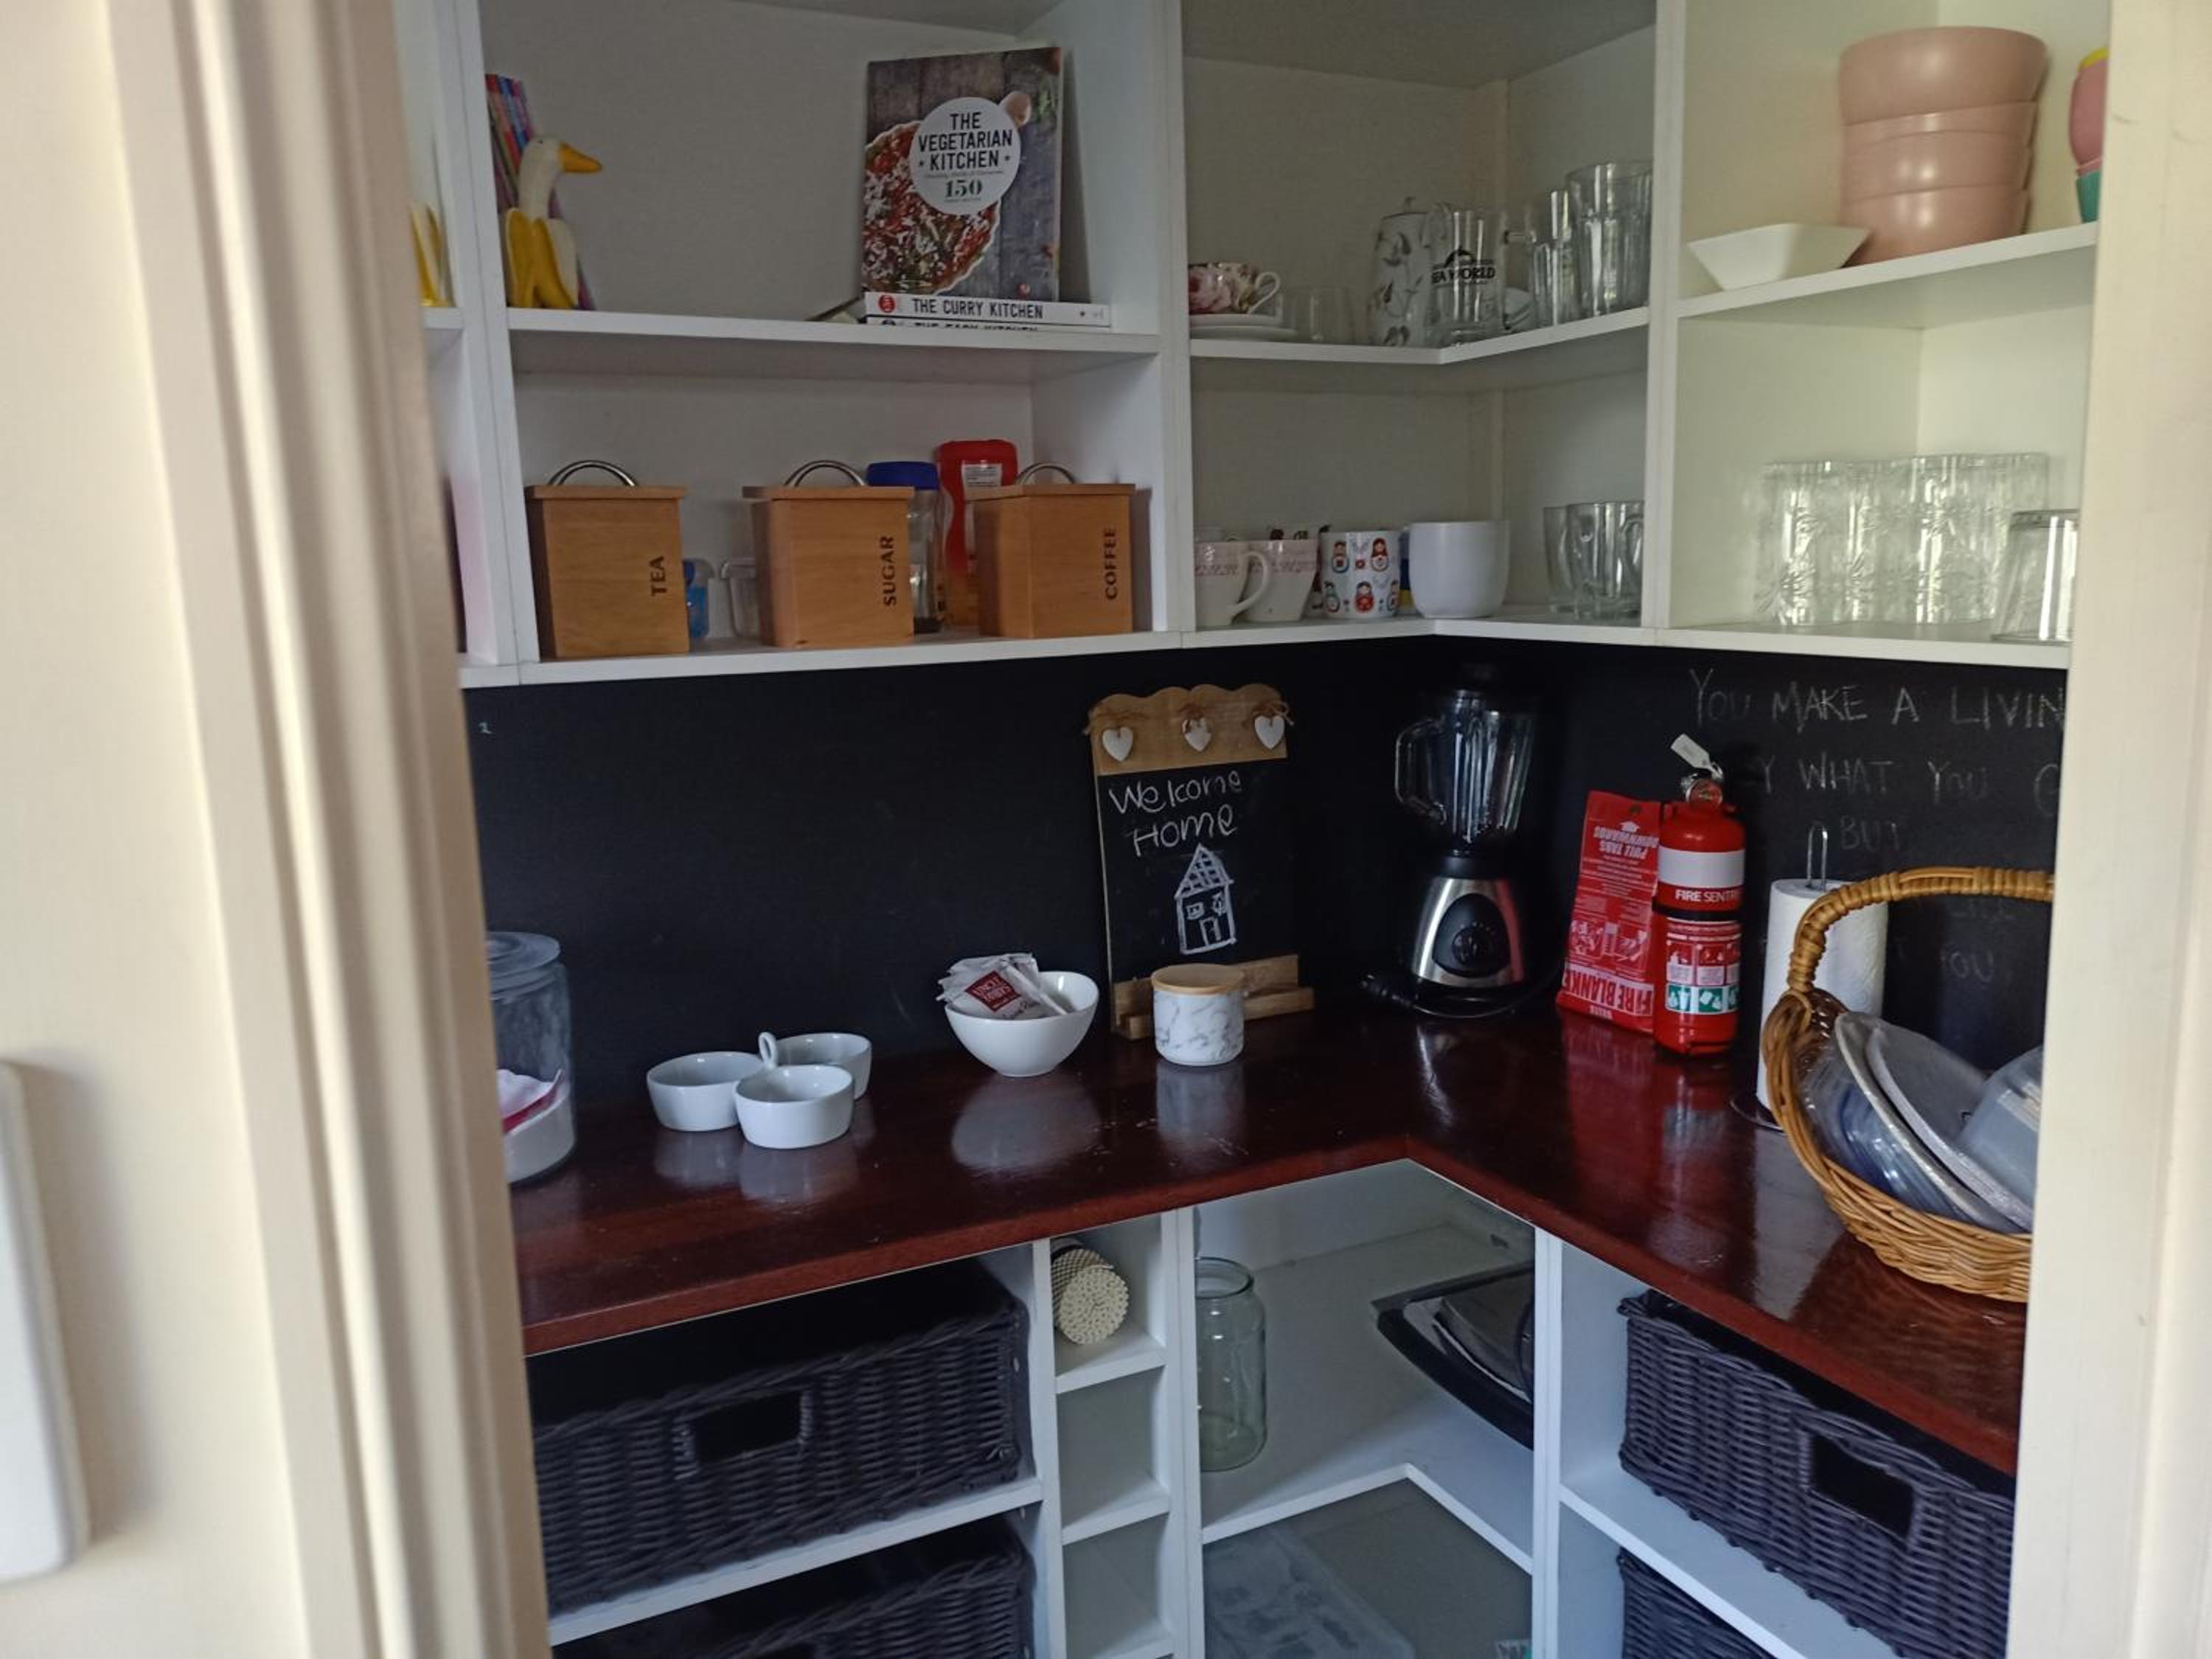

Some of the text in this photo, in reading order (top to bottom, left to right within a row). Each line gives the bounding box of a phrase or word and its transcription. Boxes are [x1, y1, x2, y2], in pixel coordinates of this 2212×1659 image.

[950, 112, 982, 131] THE
[919, 129, 1013, 152] VEGETARIAN
[930, 150, 999, 171] KITCHEN
[945, 179, 983, 198] 150
[912, 298, 937, 313] THE
[943, 299, 983, 316] CURRY
[990, 302, 1043, 319] KITCHEN
[649, 555, 667, 597] TEA
[880, 536, 897, 606] SUGAR
[1103, 529, 1118, 599] COFFEE
[1772, 681, 1869, 734] MAKE
[1891, 686, 1920, 725] A
[1798, 751, 1898, 795] WHAT
[1109, 769, 1243, 814] Welcome
[1674, 888, 1702, 902] FIRE
[1618, 984, 1653, 1015] FIRE
